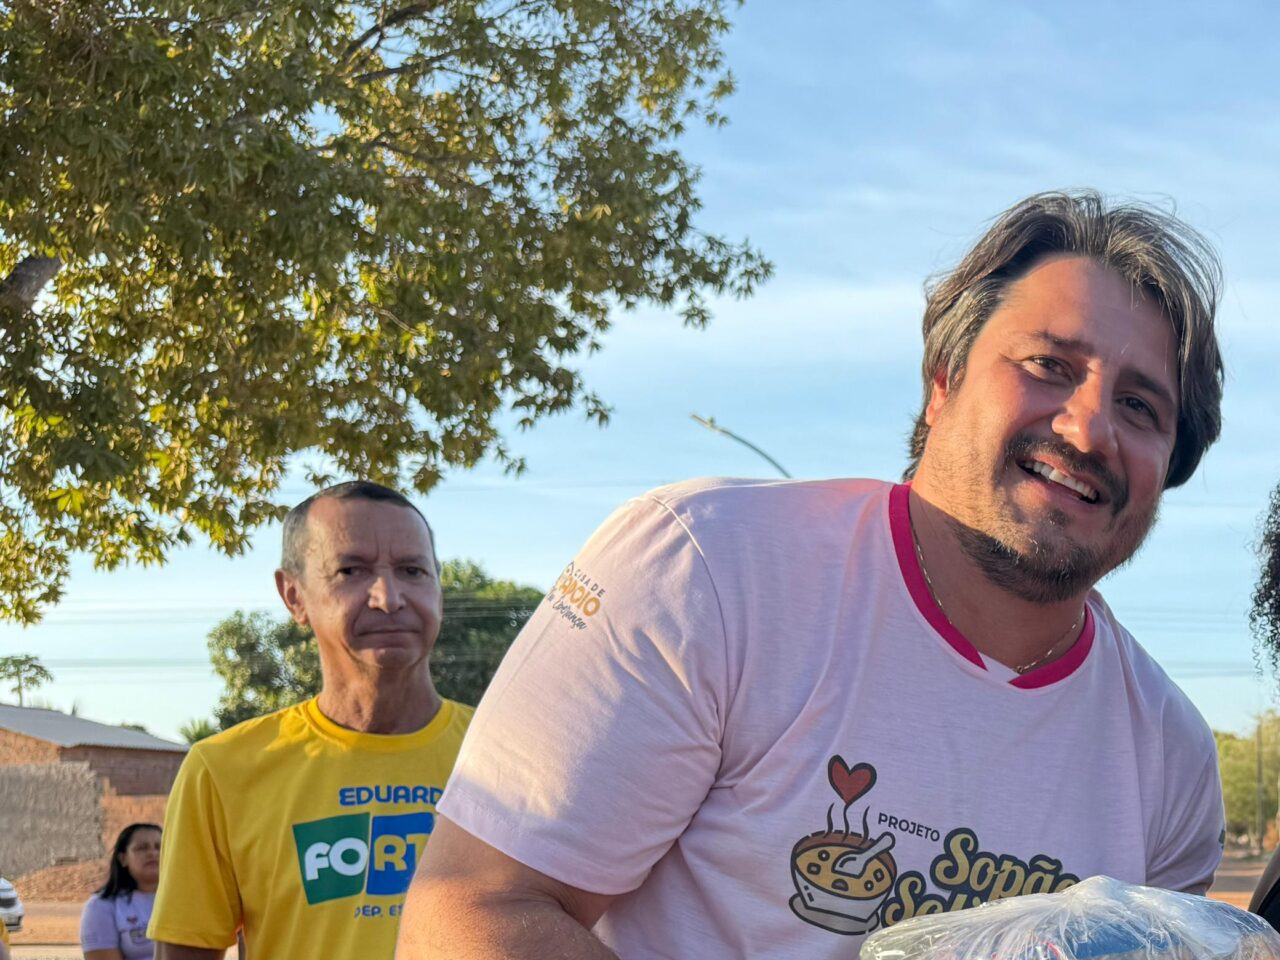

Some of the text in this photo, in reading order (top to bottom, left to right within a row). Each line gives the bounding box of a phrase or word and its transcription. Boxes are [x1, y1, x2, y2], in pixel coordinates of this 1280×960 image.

[590, 583, 606, 598] DE
[339, 785, 444, 807] EDUARD
[878, 812, 940, 842] PROJETO
[304, 833, 433, 881] FORT
